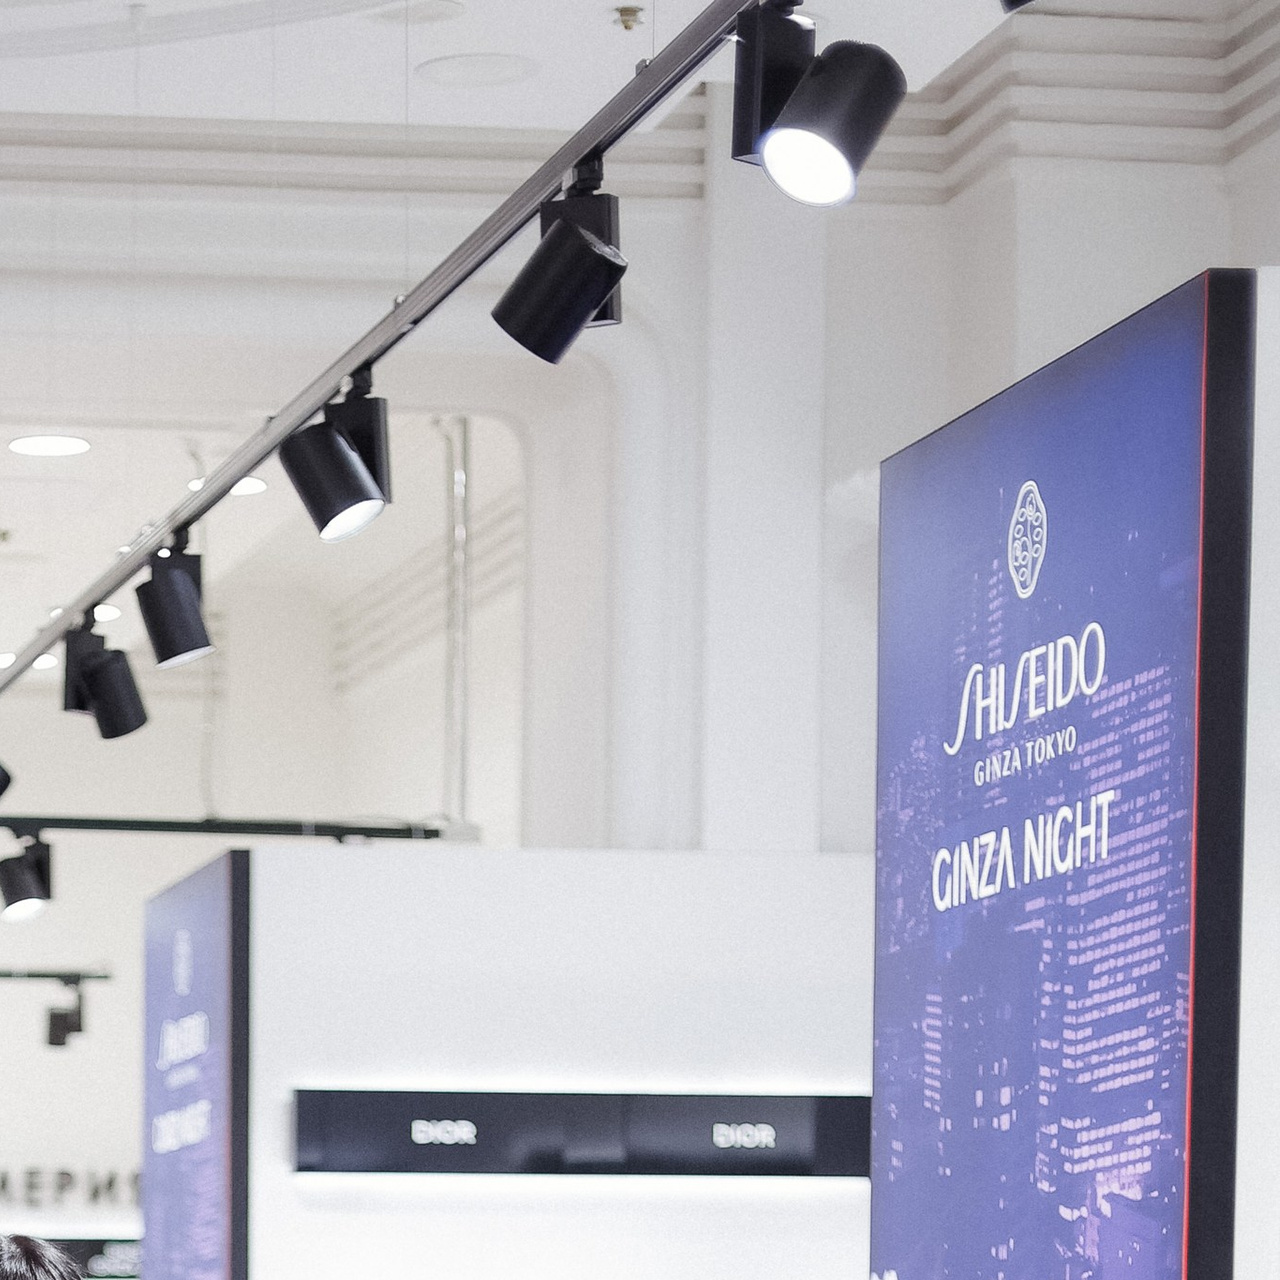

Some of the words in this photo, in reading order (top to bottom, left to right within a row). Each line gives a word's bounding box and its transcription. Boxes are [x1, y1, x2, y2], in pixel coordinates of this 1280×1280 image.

[943, 621, 1106, 757] SHISEIDO
[973, 746, 1022, 787] GINZA
[1025, 725, 1077, 768] TOKYO
[932, 826, 1016, 911] GINZA
[1023, 790, 1115, 885] NIGHT
[712, 1122, 777, 1149] DIOR
